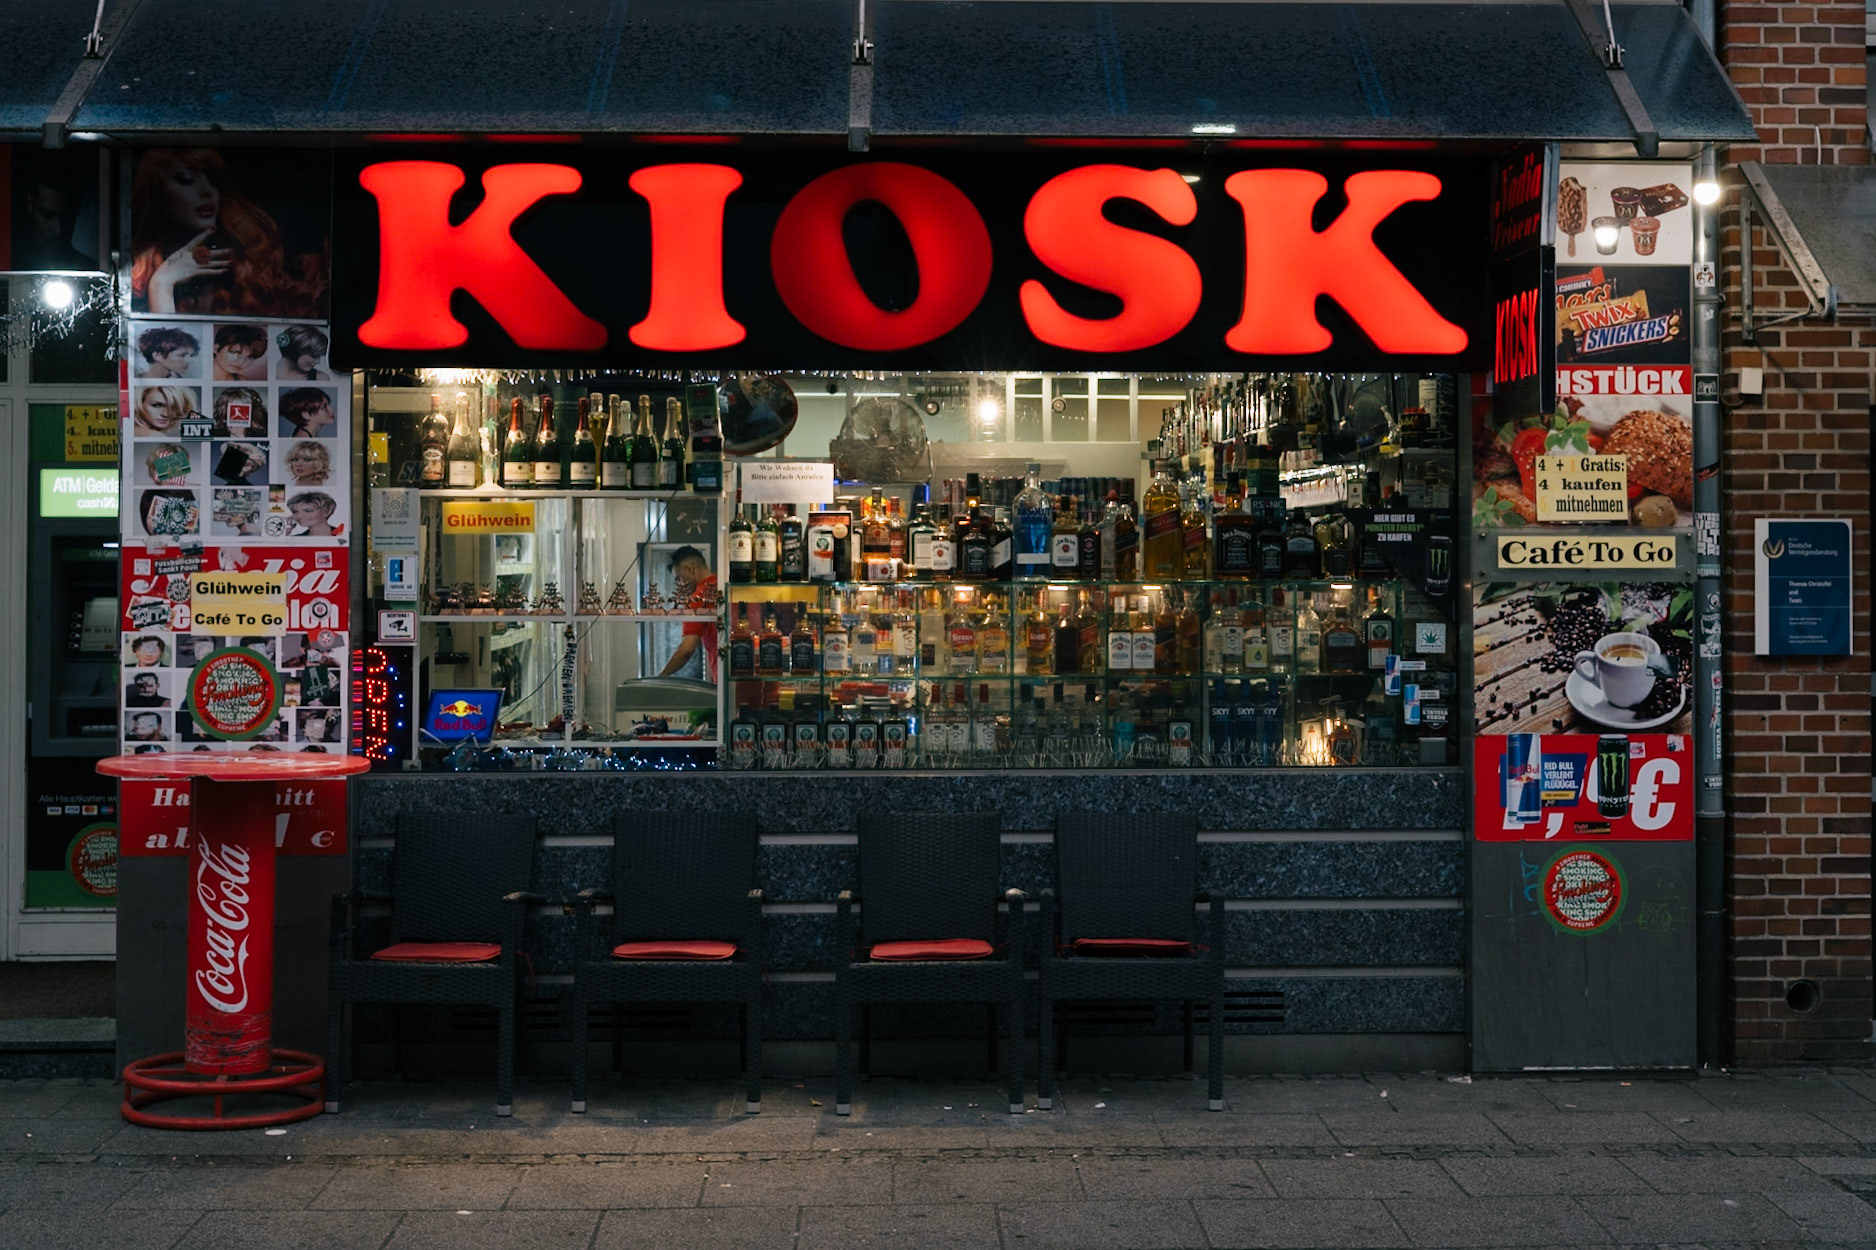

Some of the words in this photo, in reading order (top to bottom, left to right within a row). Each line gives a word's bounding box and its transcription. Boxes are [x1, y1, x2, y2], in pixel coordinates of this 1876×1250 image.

[357, 160, 1469, 355] KIOSK
[1570, 301, 1637, 331] Twix
[1495, 289, 1538, 383] KIOSK
[1586, 317, 1667, 351] SNICKERS
[1581, 457, 1625, 472] Gratis:
[53, 477, 82, 493] ATM
[1562, 477, 1623, 491] kaufen
[1556, 494, 1624, 513] mitnehmen
[447, 513, 531, 527] Glühwein
[1373, 514, 1390, 522] HIER
[1390, 514, 1406, 522] GIBT
[1406, 514, 1415, 522] ES
[1365, 523, 1395, 532] MONSTER
[1387, 533, 1412, 541] KAUFEN
[1501, 540, 1585, 565] Café
[1588, 542, 1624, 563] To
[1633, 541, 1674, 563] Go
[195, 581, 282, 595] Glühwein
[194, 613, 231, 626] Café
[236, 614, 256, 626] To
[261, 614, 283, 626] Go
[1211, 707, 1230, 717] SKYY
[1237, 707, 1256, 716] SKYY
[434, 717, 460, 731] Red
[462, 717, 487, 731] Bull
[1544, 761, 1557, 770] RED
[1558, 761, 1574, 770] BULL
[1544, 771, 1574, 780] VERLEIHT
[1559, 854, 1591, 867] SMOOTHER
[1563, 874, 1606, 882] SMOKING
[195, 831, 250, 1013] Coca-Cola
[1567, 920, 1595, 928] SUPREME
